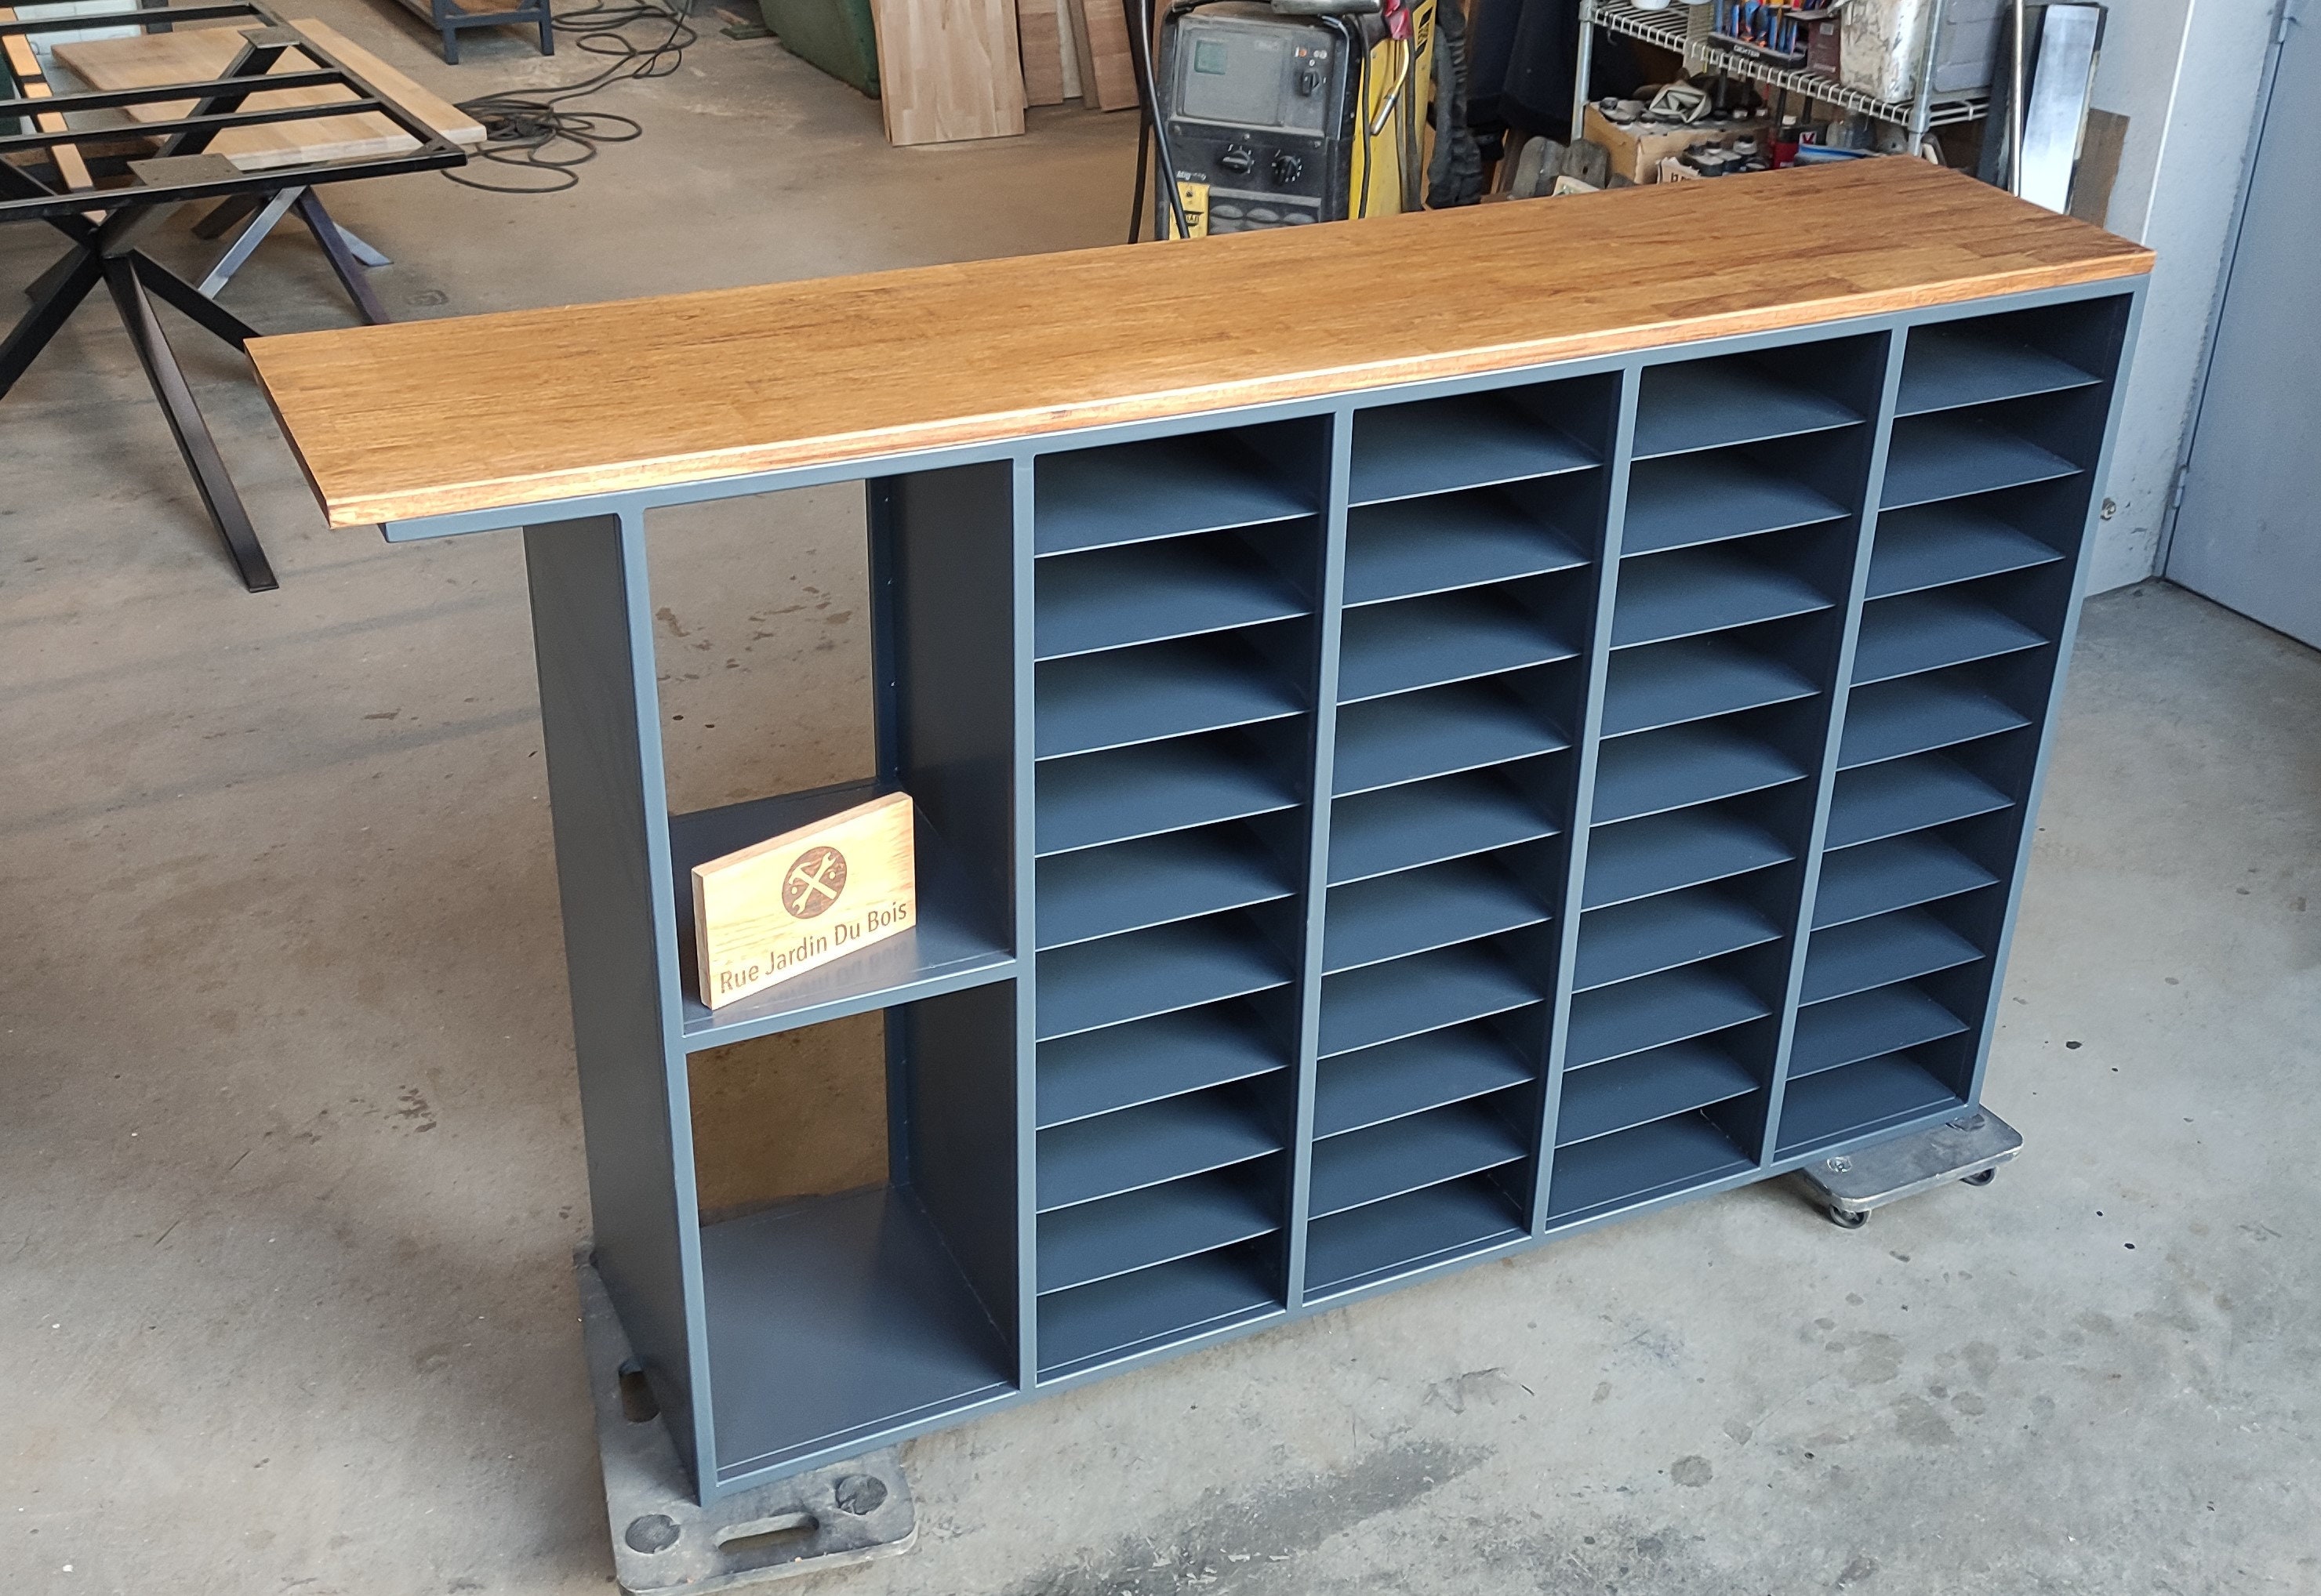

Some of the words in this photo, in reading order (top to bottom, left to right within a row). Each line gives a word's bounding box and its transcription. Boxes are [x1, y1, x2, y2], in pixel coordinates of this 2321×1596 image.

[720, 965, 759, 994] Rue
[765, 935, 827, 975] Jardin
[834, 923, 860, 946] Du
[867, 901, 906, 933] Bois
